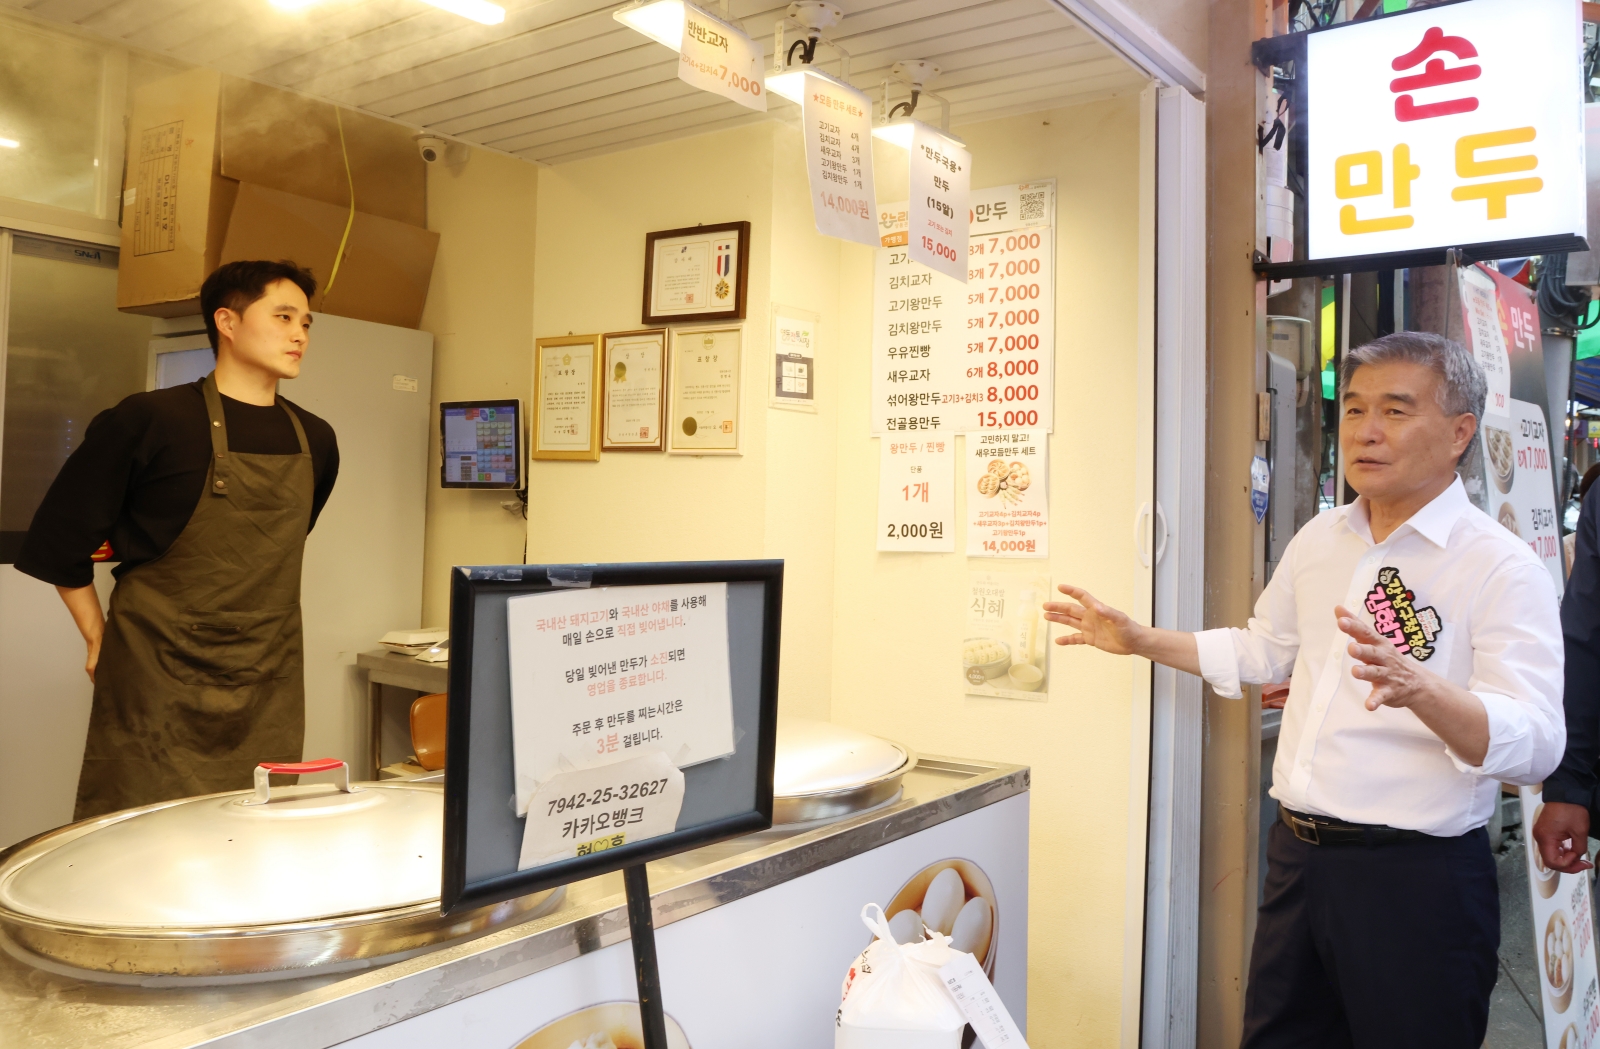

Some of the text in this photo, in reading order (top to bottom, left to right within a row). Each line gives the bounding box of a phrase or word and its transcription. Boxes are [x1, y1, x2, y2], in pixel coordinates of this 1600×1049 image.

[688, 19, 728, 53] 반반교자
[719, 64, 761, 96] 7,000
[1389, 26, 1482, 122] 손
[819, 121, 841, 136] 고기교자
[819, 133, 841, 148] 김치교자
[820, 145, 842, 160] 새우교자
[821, 158, 847, 174] 고기왕만두
[822, 170, 848, 186] 김치왕만두
[933, 175, 949, 192] 만두
[1334, 126, 1544, 235] 만두
[820, 191, 870, 220] 14,000원
[975, 201, 1008, 222] 만두
[927, 219, 936, 229] 고기
[921, 235, 957, 262] 15,000
[989, 233, 1041, 256] 7,000
[889, 273, 932, 290] 김치교자
[988, 258, 1040, 280] 7,000
[888, 284, 1040, 312] 고기왕만두 5개 7,000
[888, 308, 1040, 337] 김치왕만두 5개 7,000
[1510, 306, 1536, 353] 만두
[887, 334, 1040, 360] 우유찐빵 5개 7,000
[886, 359, 1039, 383] 새우교자 6개 8,000
[886, 384, 1039, 407] 섞어왕만두 고기3+김치3 8,000
[886, 409, 1039, 431] 전골용만두 15,000
[1522, 419, 1545, 443] 고기교자
[889, 442, 918, 455] 왕만두
[925, 441, 946, 453] 찐빵
[980, 433, 1030, 445] 고민하지 말고!
[1020, 446, 1037, 456] 세트
[1527, 446, 1548, 472] 7,000
[901, 481, 930, 503] 1개
[887, 521, 944, 540] 2,000원
[1531, 507, 1554, 531] 김치교자
[982, 539, 1036, 554] 14,000원
[1537, 535, 1557, 562] 7,000
[536, 594, 707, 632] 국내산 돼지고기와 국내산 야채를 사용해
[970, 597, 1005, 619] 식혜
[1386, 577, 1426, 647] 강남구청장
[562, 615, 687, 647] 매일 손으로 직접 빚어냅니다.
[565, 648, 686, 684] 당일 빚어낸 만두가 소진되면
[587, 669, 668, 697] 영업을 종료합니다.
[572, 699, 684, 737] 주문 후 만두를 찌는시간은
[597, 727, 663, 754] 3분 걸립니다.
[547, 778, 668, 817] 7942-25-32627
[562, 806, 644, 839] 카카오뱅크
